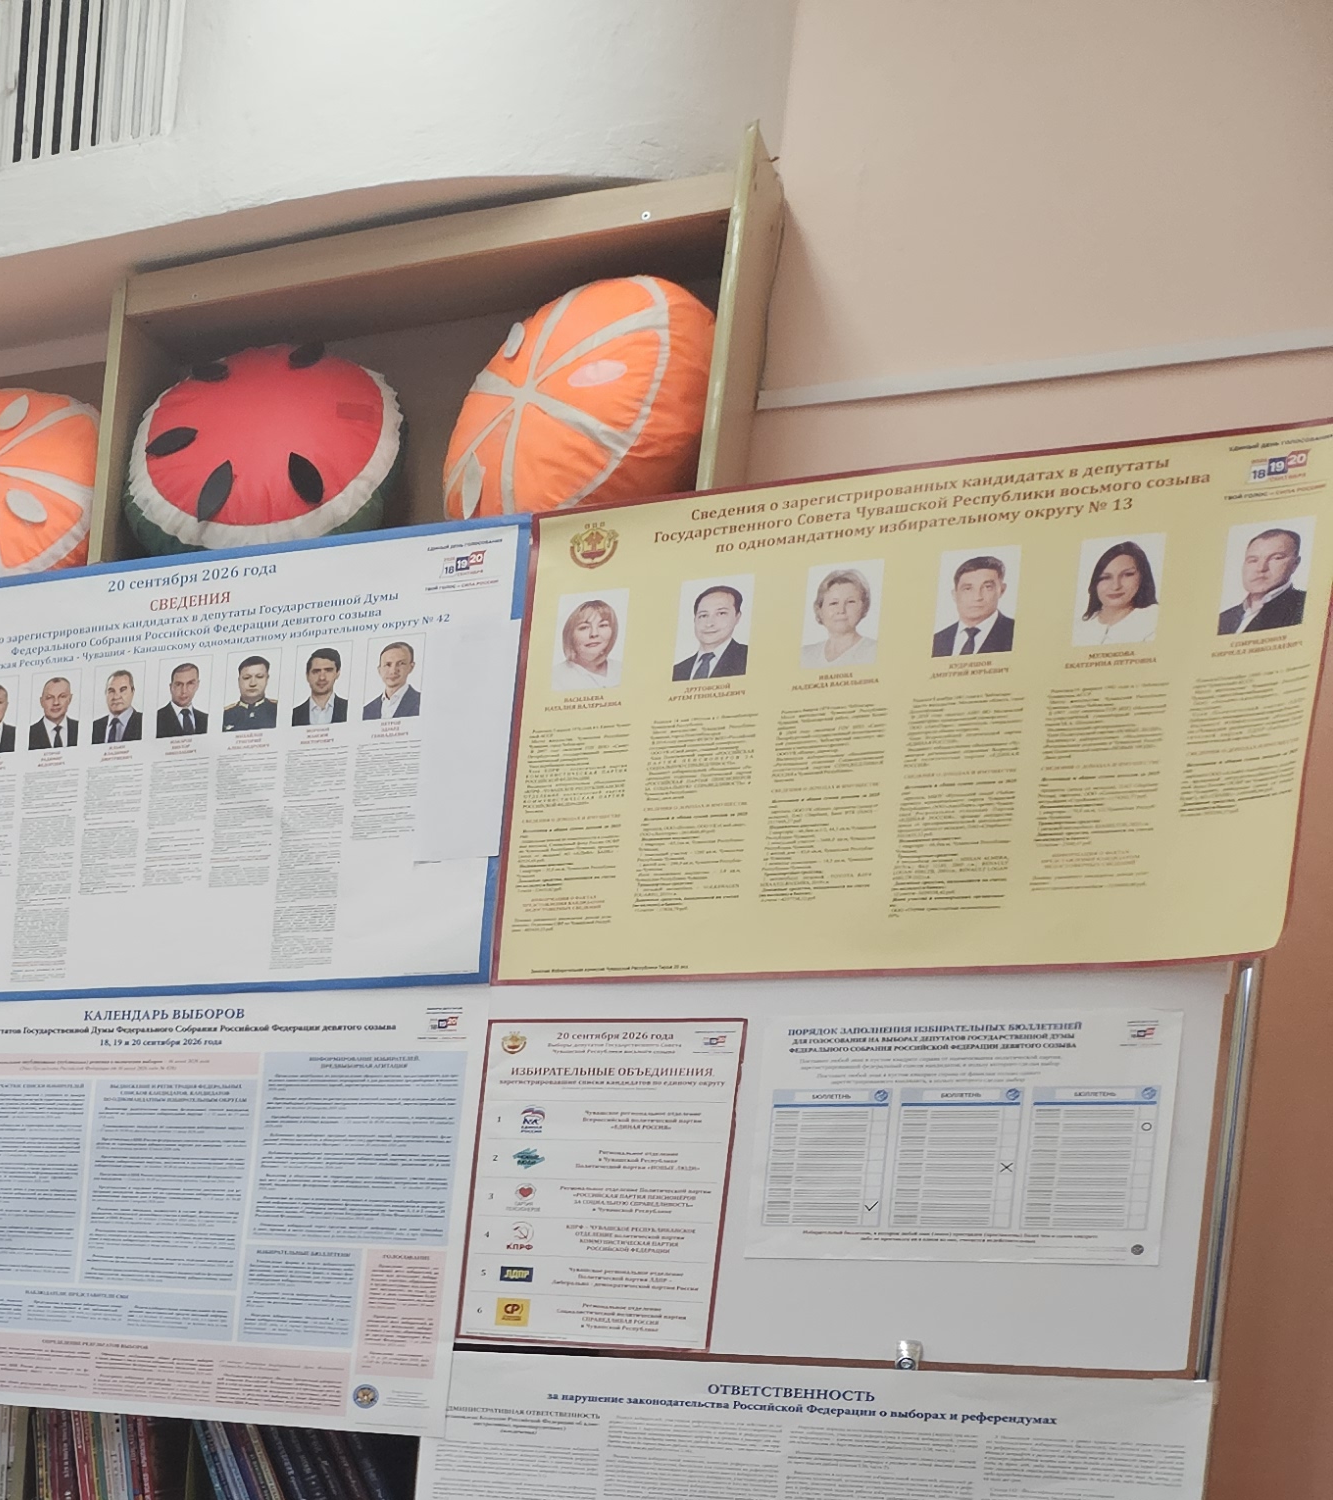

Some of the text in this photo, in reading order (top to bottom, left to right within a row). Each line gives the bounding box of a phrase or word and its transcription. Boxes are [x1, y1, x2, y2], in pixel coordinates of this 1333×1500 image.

[1252, 454, 1306, 480] 18 19 20
[691, 458, 1169, 521] Сведения о зарегистрированных кандидатах в депутаты
[653, 474, 1210, 543] Государственного Совета Чувашской Республики восьмого созыва
[715, 498, 1133, 553] по одномандатному избирательному округу № 13
[469, 554, 483, 563] 20
[108, 564, 277, 592] 20 сентября 2026 года
[150, 590, 231, 612] СВЕДЕНИЯ
[7, 623, 120, 643] зарегистрированных
[122, 615, 189, 629] кандидатах
[191, 614, 198, 622] в
[200, 608, 256, 622] депутаты
[259, 595, 362, 615] Государственной
[363, 593, 399, 605] Думы
[11, 609, 382, 655] Федерального Собрания Российской Федерации девятого созыва
[19, 654, 74, 667] Республика
[82, 649, 125, 661] Чувашия
[133, 641, 197, 654] Канашскому
[198, 632, 288, 648] одномандатному
[289, 623, 380, 638] избирательному
[381, 619, 420, 630] округу
[422, 615, 433, 625] №
[436, 614, 450, 623] 42
[84, 1008, 245, 1021] КАЛЕНДАРЬ ВЫБОРОВ
[113, 1038, 123, 1046] 19
[131, 1038, 141, 1046] 20
[142, 1038, 181, 1047] сентября
[182, 1037, 202, 1045] 2026
[511, 1066, 714, 1078] ИЗБИРАТЕЛЬНЫЕ ОБЪЕДИНЕНИЯ,
[708, 1383, 875, 1402] ОТВЕТСТВЕННОСТЬ
[547, 1392, 558, 1400] за
[561, 1393, 624, 1404] нарушение
[626, 1396, 730, 1409] законодательства
[732, 1400, 803, 1413] Российской
[806, 1403, 876, 1418] Федерации
[879, 1409, 887, 1417] о
[890, 1408, 947, 1421] выборах
[961, 1412, 1057, 1426] референдумах
